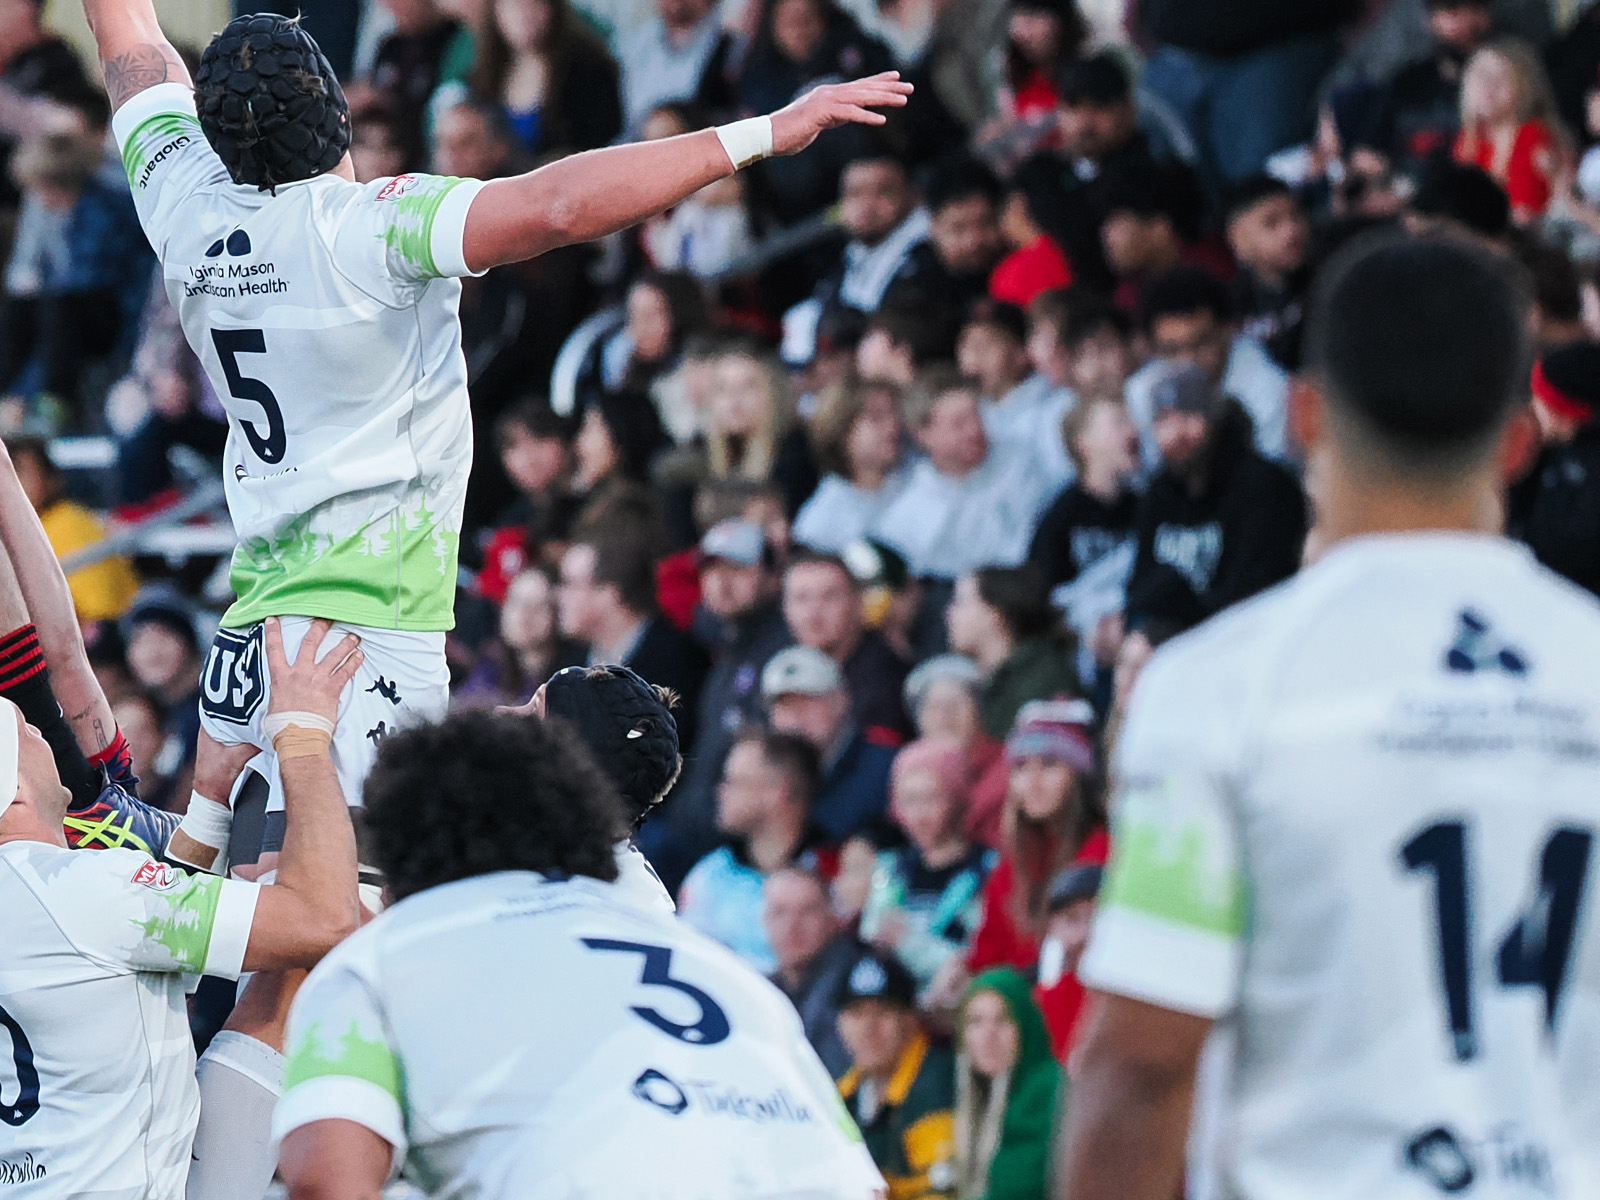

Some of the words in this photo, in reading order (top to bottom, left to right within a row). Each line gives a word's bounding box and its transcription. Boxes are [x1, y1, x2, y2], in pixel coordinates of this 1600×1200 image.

[139, 135, 191, 190] Globant
[228, 262, 275, 278] Mason
[238, 278, 288, 296] Health
[210, 328, 287, 464] 5
[1400, 817, 1596, 1063] 14
[578, 936, 731, 1046] 3
